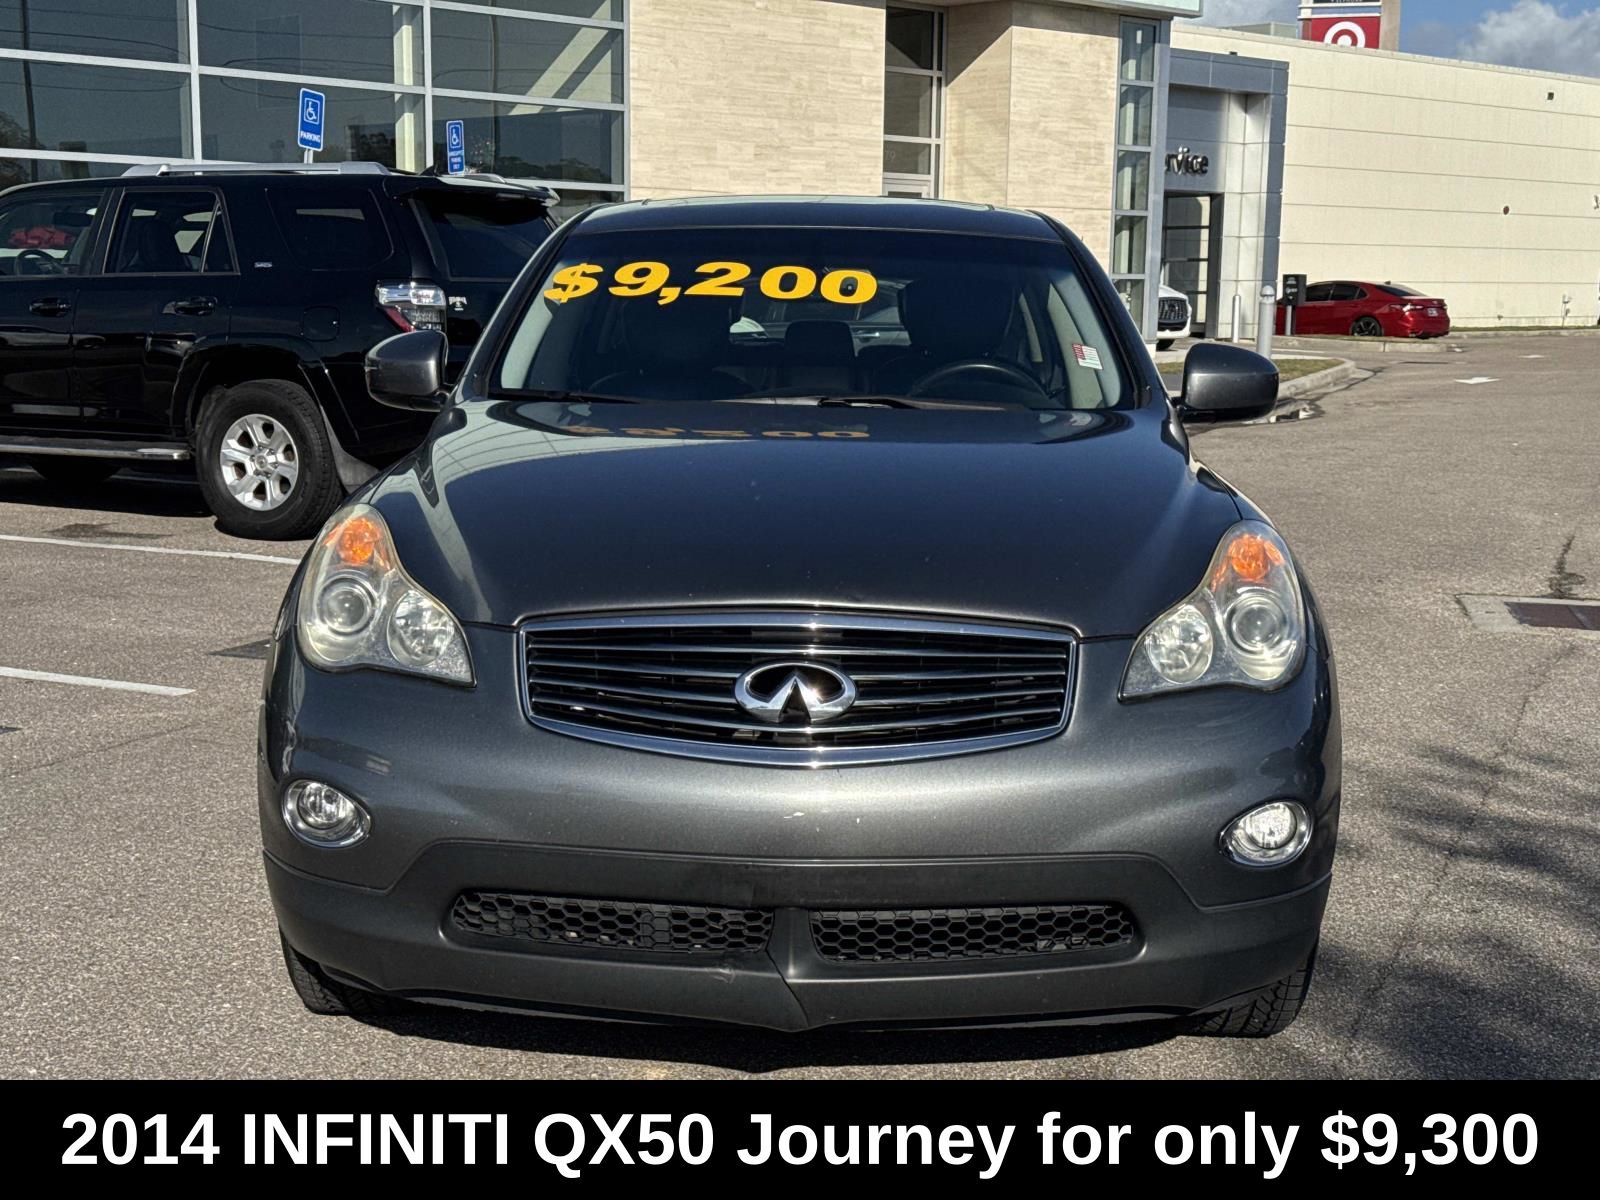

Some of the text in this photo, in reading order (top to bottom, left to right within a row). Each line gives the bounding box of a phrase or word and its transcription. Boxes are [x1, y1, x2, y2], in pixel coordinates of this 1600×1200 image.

[300, 130, 321, 143] PARKING
[1165, 147, 1209, 175] rvice
[543, 261, 878, 305] $9,200
